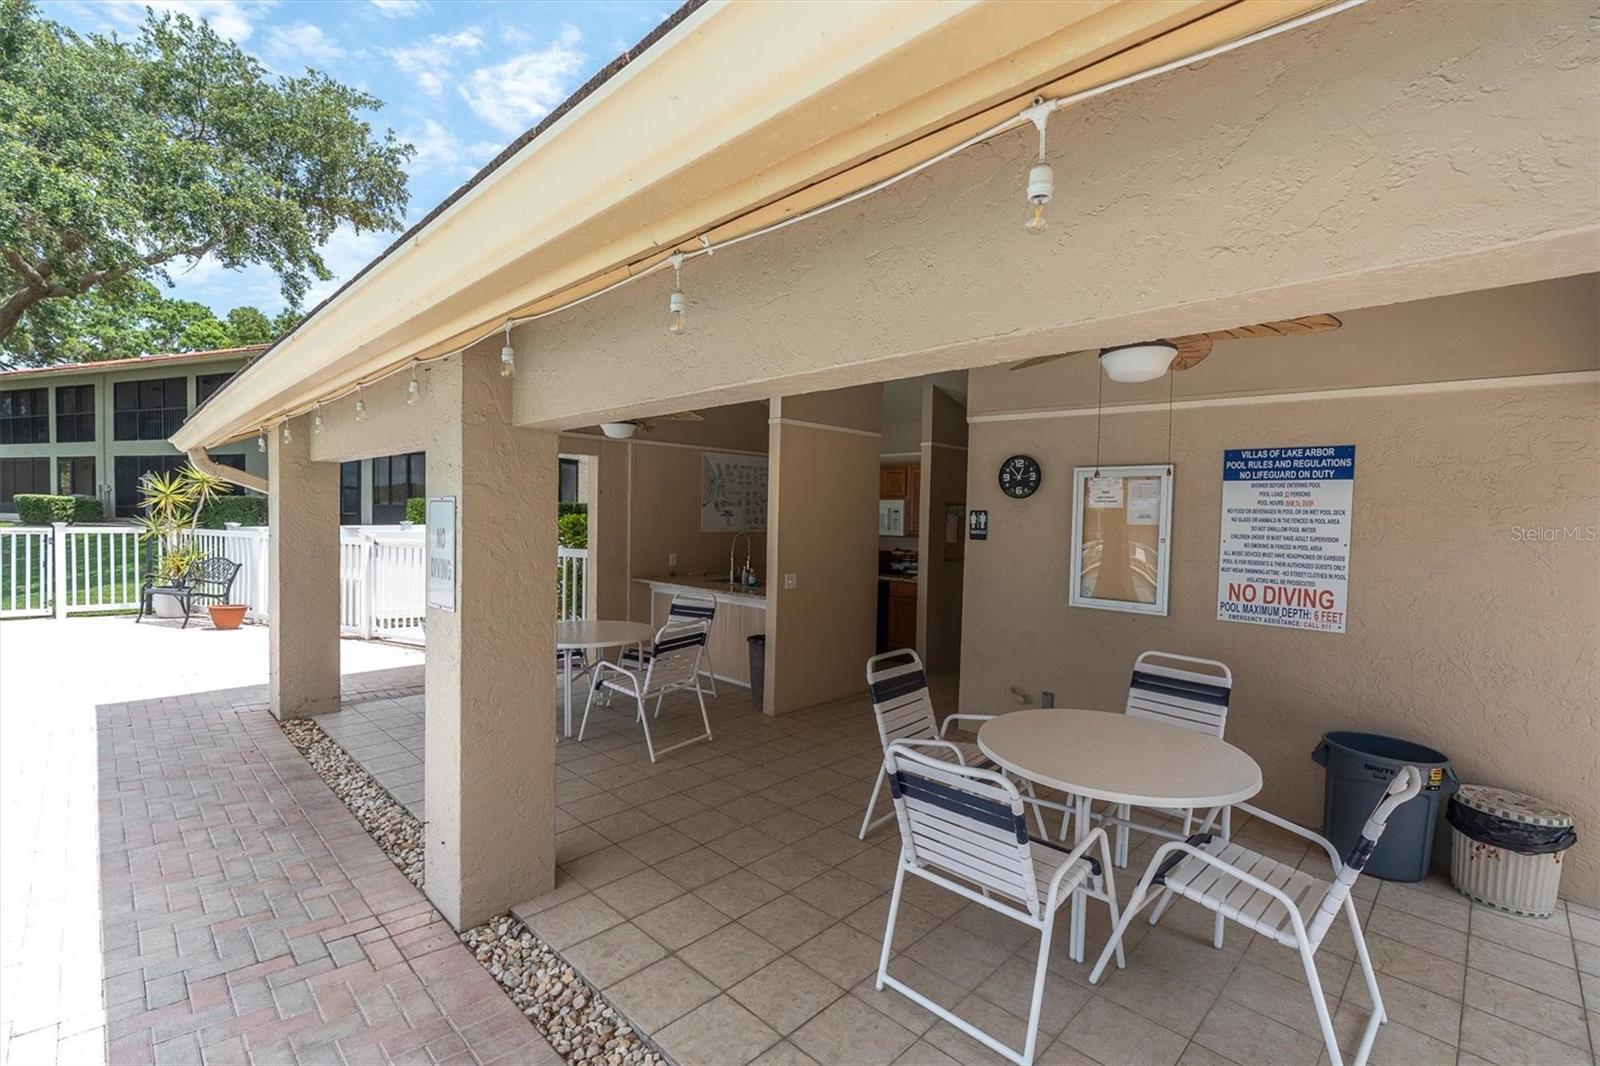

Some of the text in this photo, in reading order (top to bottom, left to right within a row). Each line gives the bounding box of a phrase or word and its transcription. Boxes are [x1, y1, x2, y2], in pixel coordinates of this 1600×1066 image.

[1305, 448, 1334, 456] ARBOR
[1226, 459, 1352, 469] POOL RULES AND REGULATIONS
[1253, 471, 1296, 479] LIFEGUARD
[1312, 470, 1335, 478] DUTY
[436, 528, 446, 549] NO
[431, 557, 452, 581] DIVING
[1229, 583, 1334, 610] NO DIVING
[1220, 602, 1343, 624] POOL MAXIMUM DEPTH: 6 FEET
[1228, 614, 1262, 623] EMERGENCY
[1263, 618, 1302, 626] ASSISTANCE:
[1364, 764, 1396, 775] BRUTE
